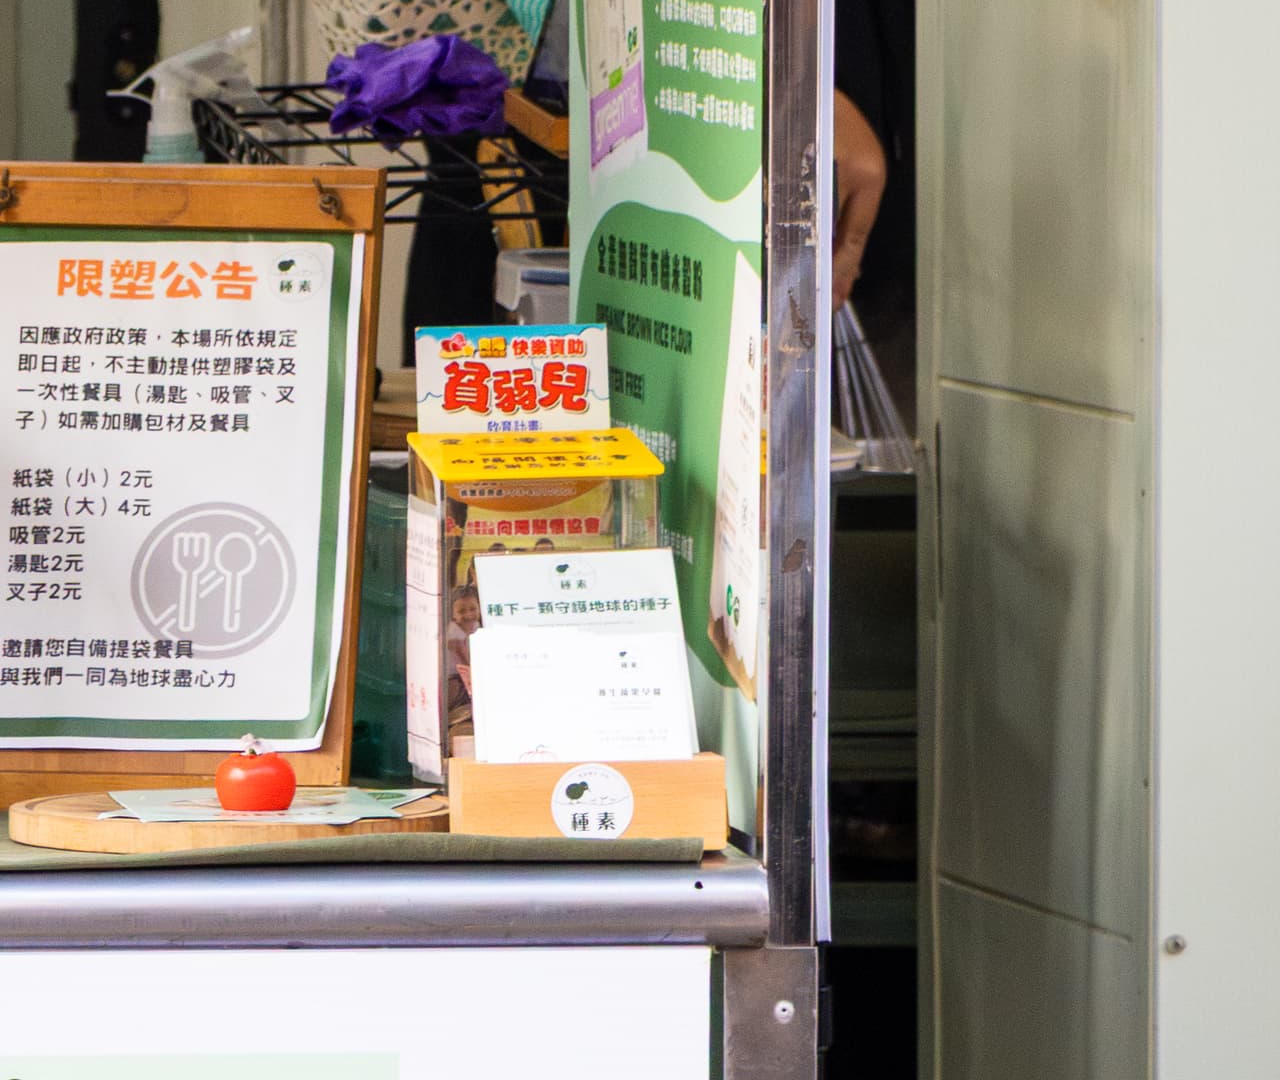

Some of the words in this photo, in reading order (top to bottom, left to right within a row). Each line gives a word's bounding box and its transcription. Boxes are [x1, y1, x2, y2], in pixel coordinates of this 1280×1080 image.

[57, 258, 258, 300] 限塑公告
[18, 353, 297, 377] 即日起，不主動提供塑膠袋及
[442, 361, 588, 414] 貧弱兒
[9, 525, 85, 546] 吸管2元
[7, 553, 84, 574] 湯匙2元
[5, 581, 82, 602] 叉子2元
[1, 637, 194, 660] 邀請您自備提袋餐具
[0, 665, 236, 689] 與我們一同為地球盡心力
[571, 811, 616, 832] 種素
